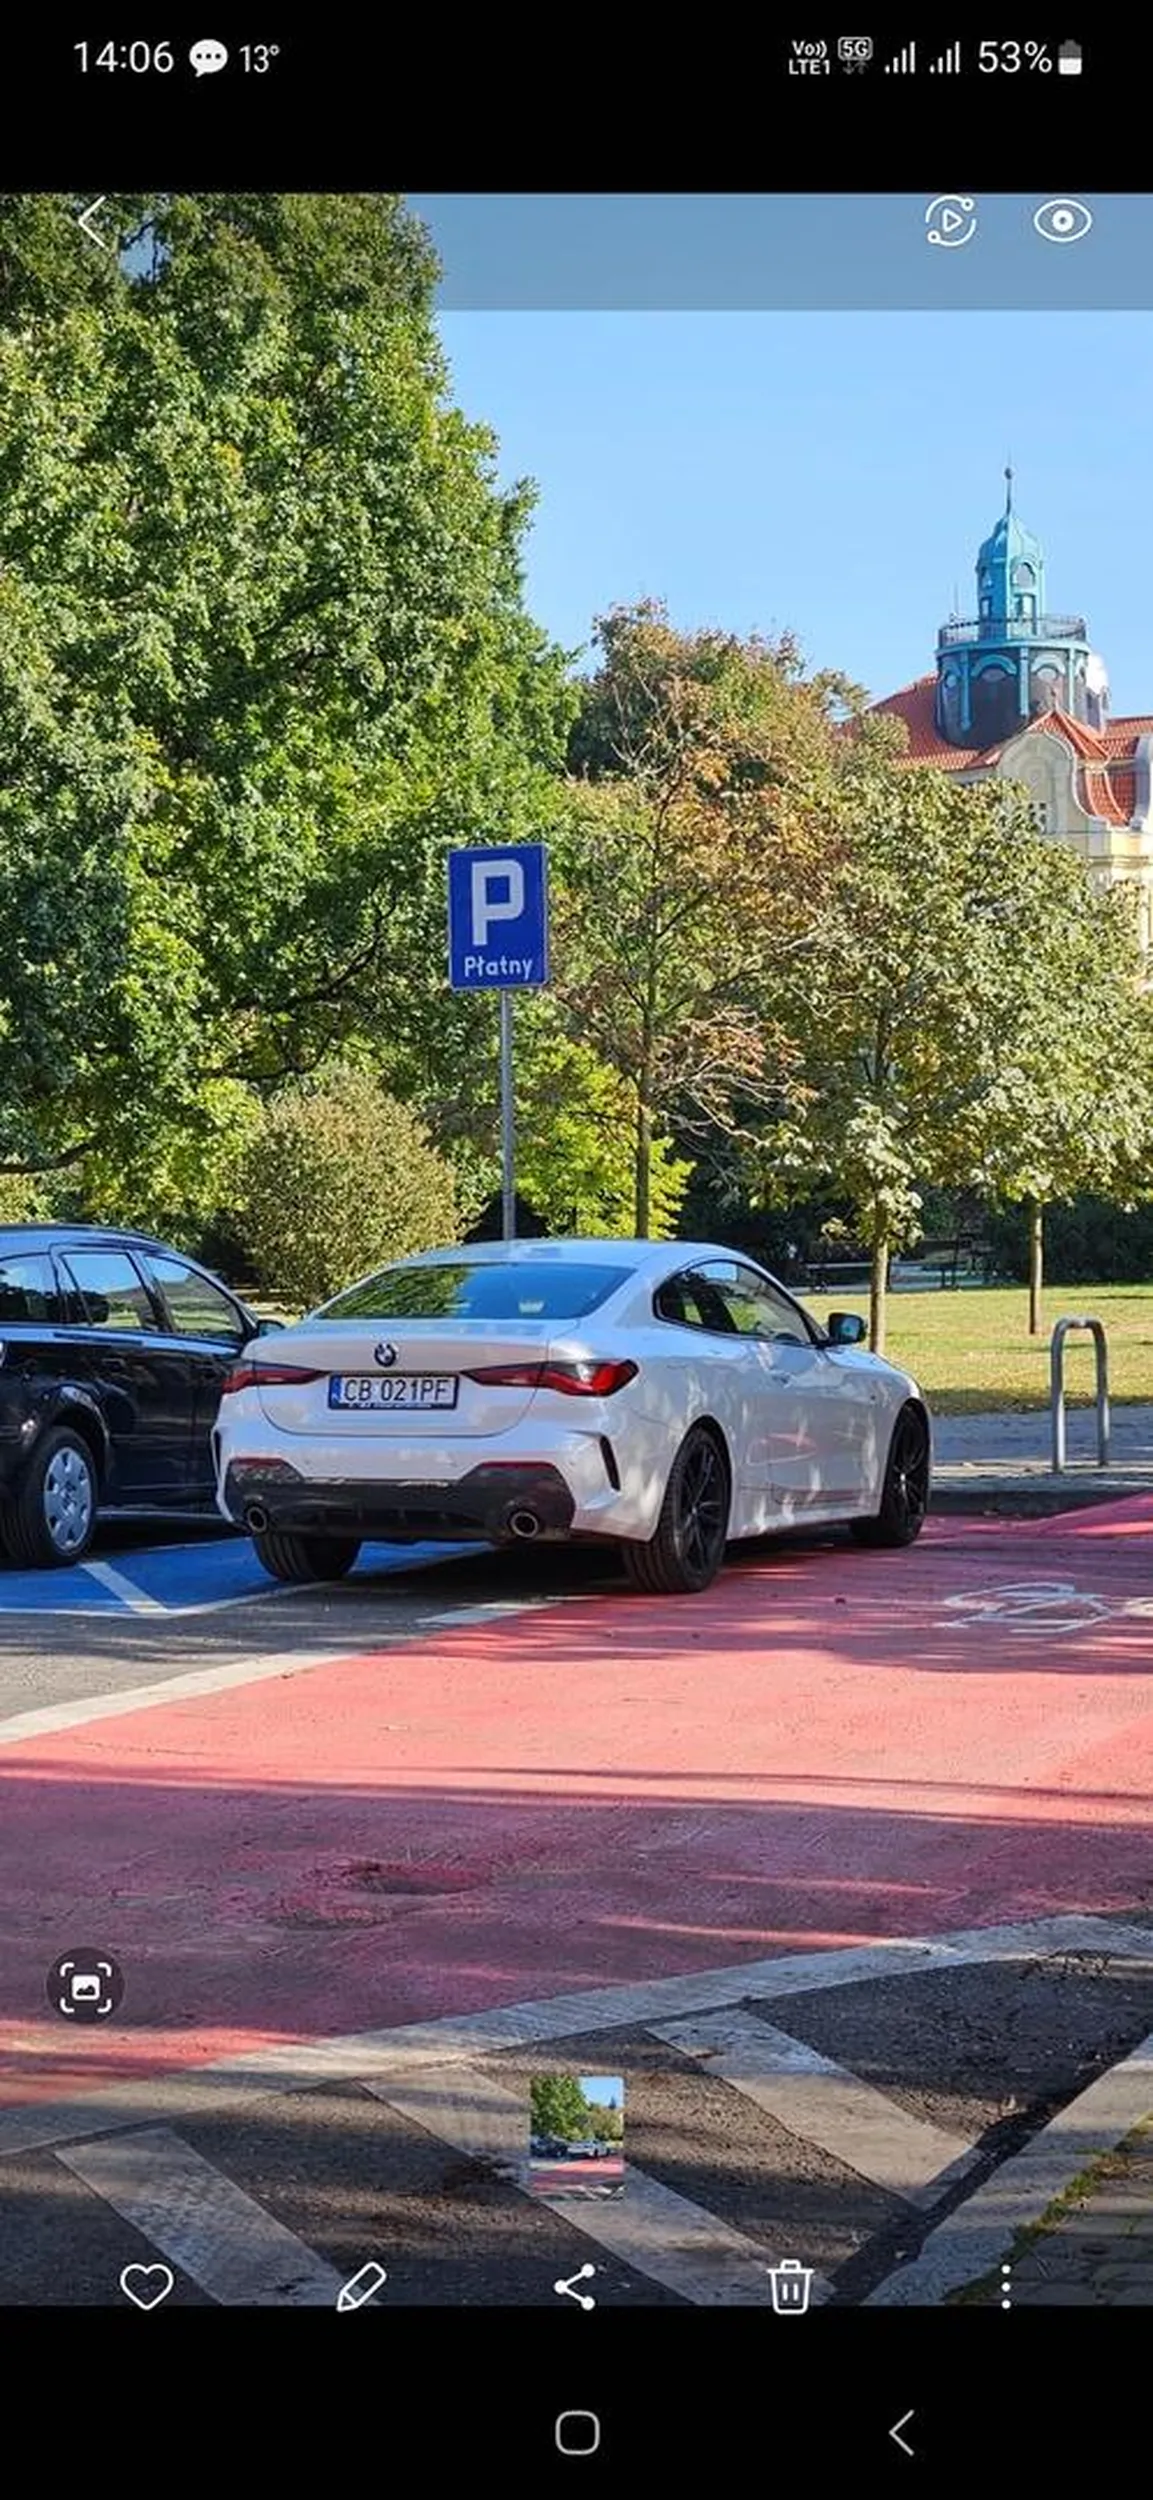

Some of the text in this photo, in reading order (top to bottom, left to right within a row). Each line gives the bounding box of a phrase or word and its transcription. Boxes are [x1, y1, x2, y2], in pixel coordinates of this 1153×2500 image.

[471, 859, 525, 946] P
[464, 955, 533, 981] Płatny
[344, 1379, 449, 1401] CB 021PF
